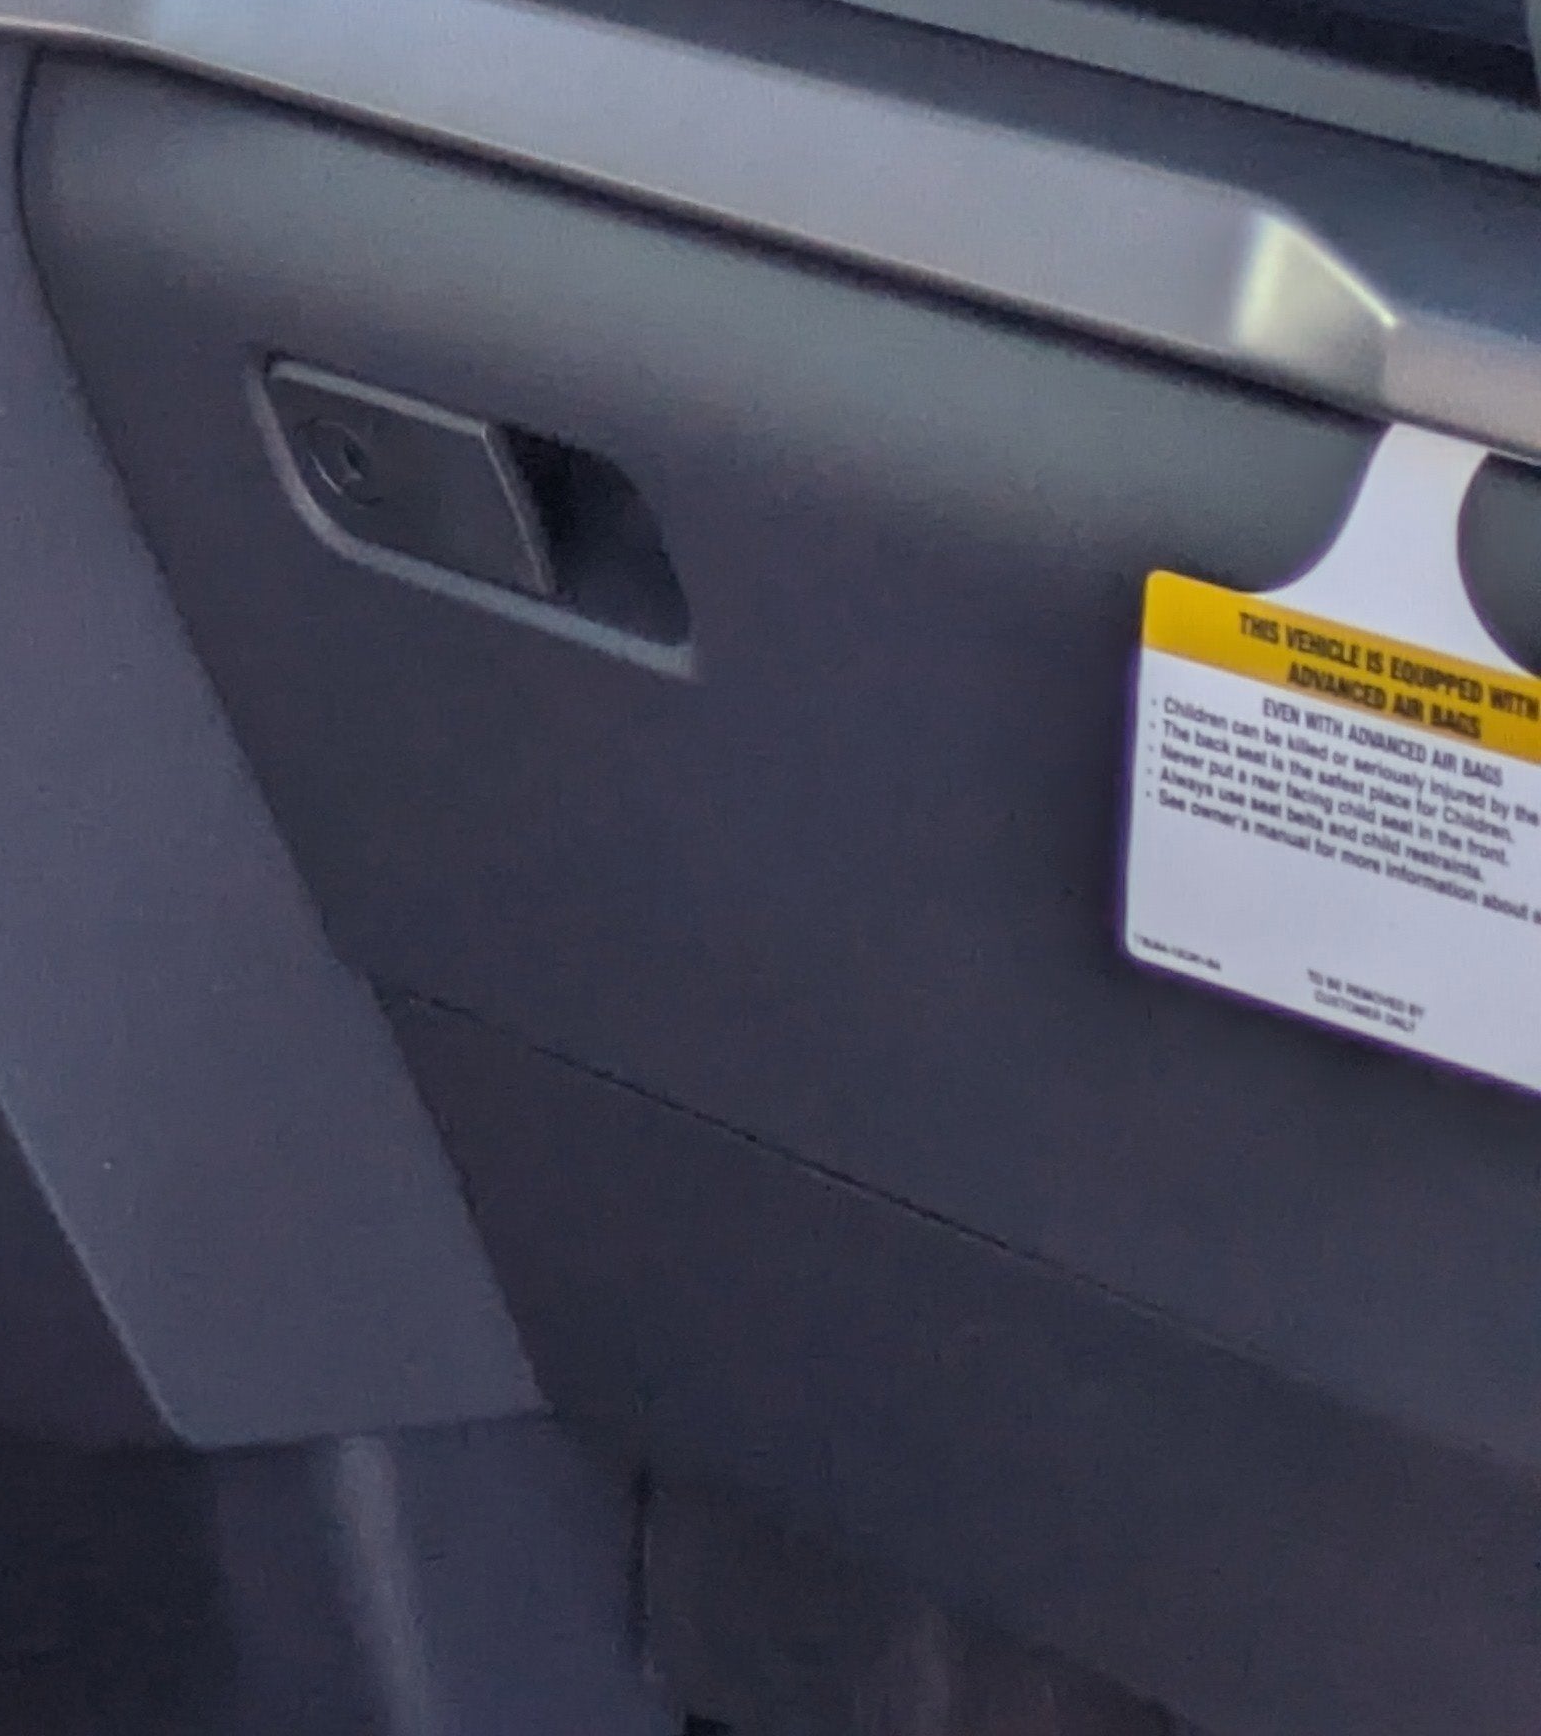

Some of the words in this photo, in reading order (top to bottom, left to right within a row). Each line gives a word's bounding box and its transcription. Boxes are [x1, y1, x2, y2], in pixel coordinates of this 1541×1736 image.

[1238, 612, 1280, 645] THIS
[1285, 624, 1361, 668] VEHICLE
[1365, 648, 1386, 675] IS
[1390, 655, 1484, 704] EQUIPPED
[1487, 685, 1540, 722] WITH
[1287, 660, 1387, 711] ADVANCED
[1392, 692, 1425, 723] AIR
[1429, 702, 1482, 740] BAGS
[1163, 719, 1190, 743] The
[1195, 730, 1230, 755] back
[1235, 744, 1267, 766] seat
[1271, 754, 1284, 772] is
[1289, 760, 1313, 780] the
[1318, 771, 1365, 796] safest
[1369, 786, 1412, 810] place
[1416, 797, 1438, 818] for
[1164, 696, 1228, 730] Children
[1232, 720, 1260, 739] can
[1264, 726, 1282, 747] be
[1287, 733, 1329, 761] killed
[1332, 750, 1349, 767] or
[1353, 758, 1425, 792] seriously
[1430, 777, 1486, 810] injured
[1490, 796, 1510, 820] by
[1514, 803, 1540, 827] the
[1263, 697, 1301, 725] EVEN
[1304, 711, 1344, 739] WITH
[1348, 724, 1427, 764] ADVANCED
[1431, 748, 1458, 773] AIR
[1462, 757, 1504, 788] BAGS
[1160, 766, 1214, 798] Always
[1218, 788, 1246, 807] use
[1250, 796, 1282, 817] seat
[1287, 806, 1324, 832] belts
[1328, 821, 1358, 843] and
[1361, 832, 1401, 856] child
[1161, 742, 1204, 769] Never
[1209, 761, 1234, 780] put
[1252, 774, 1281, 794] rear
[1286, 781, 1333, 815] facing
[1337, 800, 1376, 824] child
[1381, 814, 1413, 836] seat
[1437, 829, 1463, 852] the
[1159, 788, 1186, 812] See
[1190, 802, 1250, 833] owner's
[1254, 821, 1311, 851] manual
[1315, 838, 1337, 858] for
[1340, 850, 1381, 874] more
[1385, 861, 1478, 904] information
[1481, 894, 1529, 921] about
